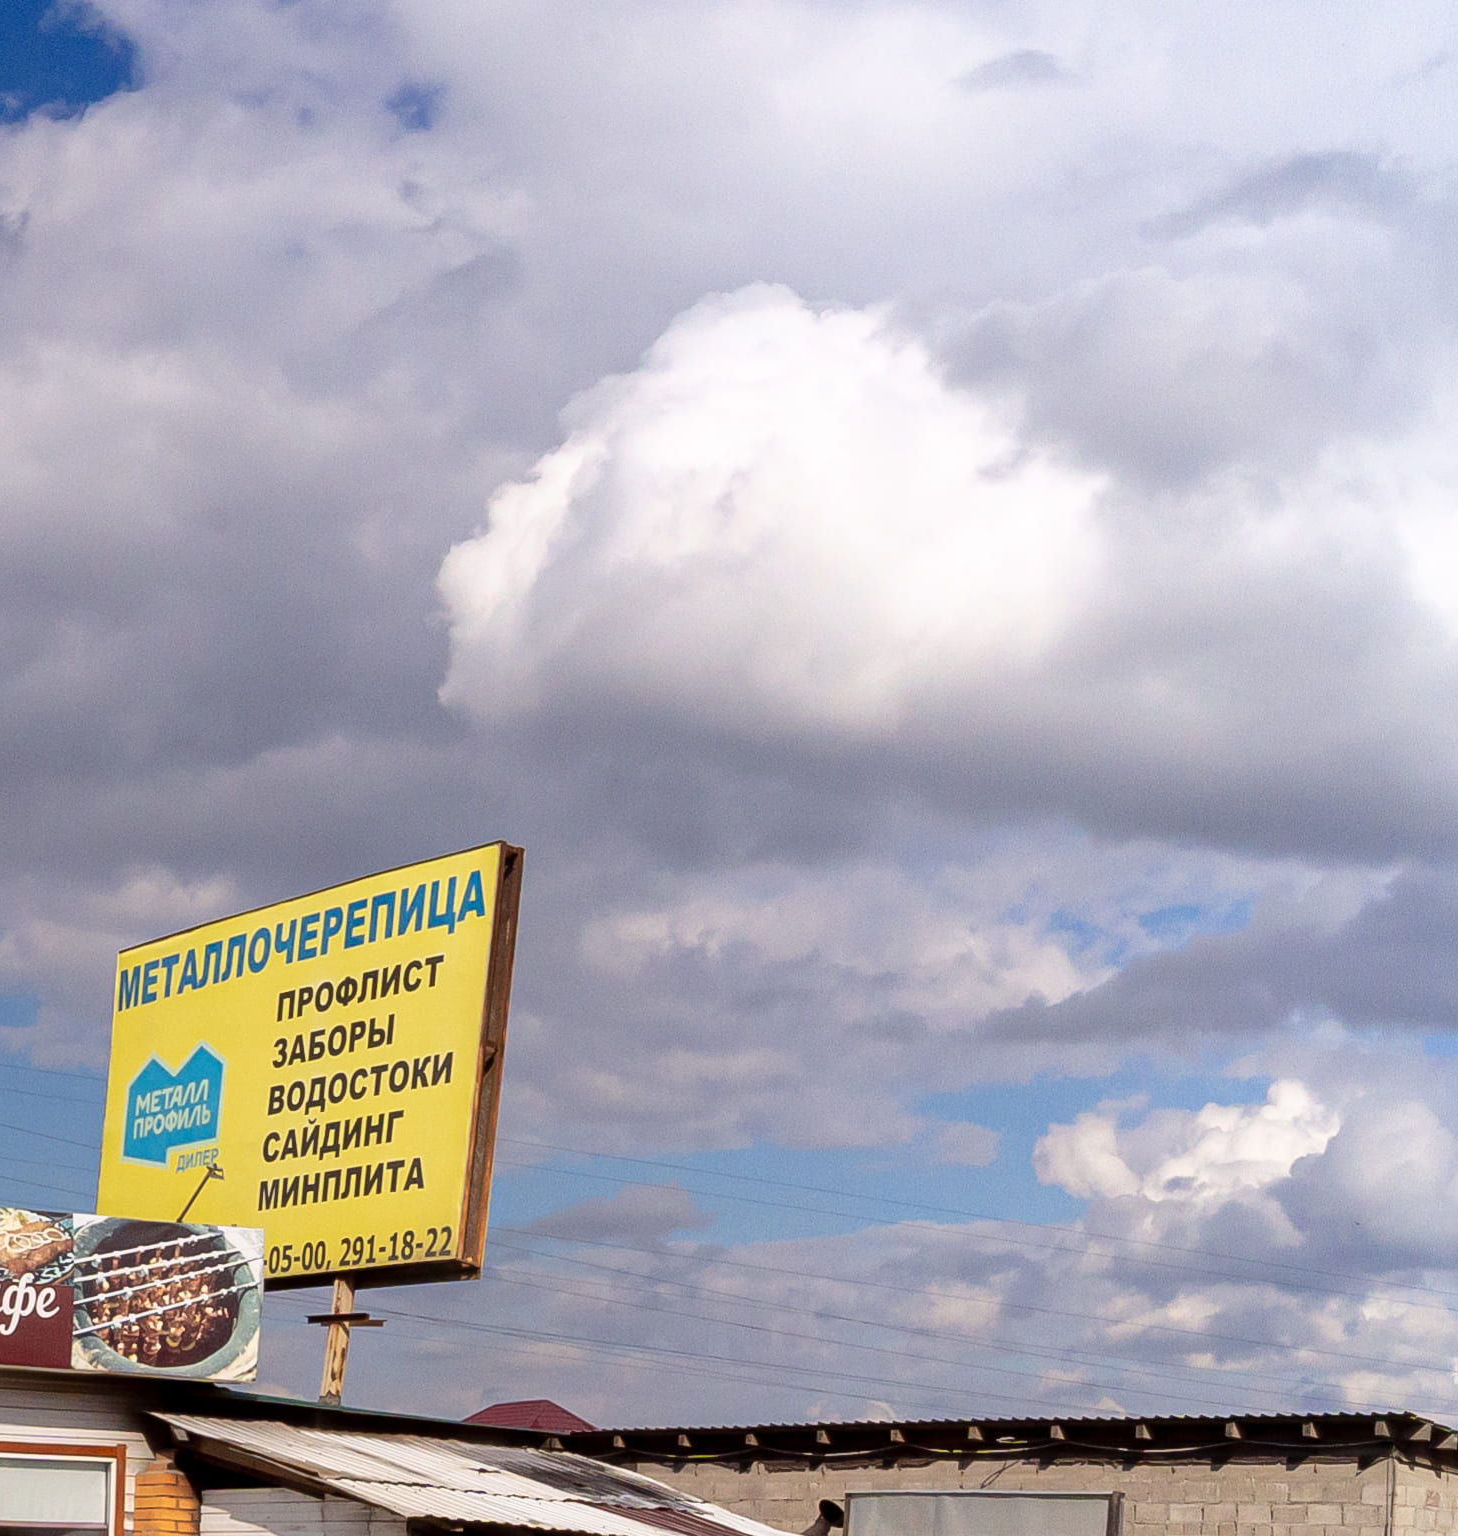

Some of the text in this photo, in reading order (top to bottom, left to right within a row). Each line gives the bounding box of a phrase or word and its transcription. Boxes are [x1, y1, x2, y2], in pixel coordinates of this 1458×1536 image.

[118, 870, 486, 1012] МЕТАЛЛОЧЕРЕПИЦА
[277, 955, 444, 1022] ПРОФЛИСТ
[272, 1014, 395, 1068] ЗАБОРЫ
[135, 1079, 210, 1116] МЕТАЛЛ
[267, 1052, 453, 1116] ВОДОСТОКИ
[133, 1104, 211, 1140] ПРОФИЛЬ
[263, 1110, 404, 1162] САЙДИНГ
[176, 1148, 219, 1174] ДИЛЕР
[258, 1158, 425, 1211] МИНПЛИТА
[339, 1226, 452, 1266] 291-18-22
